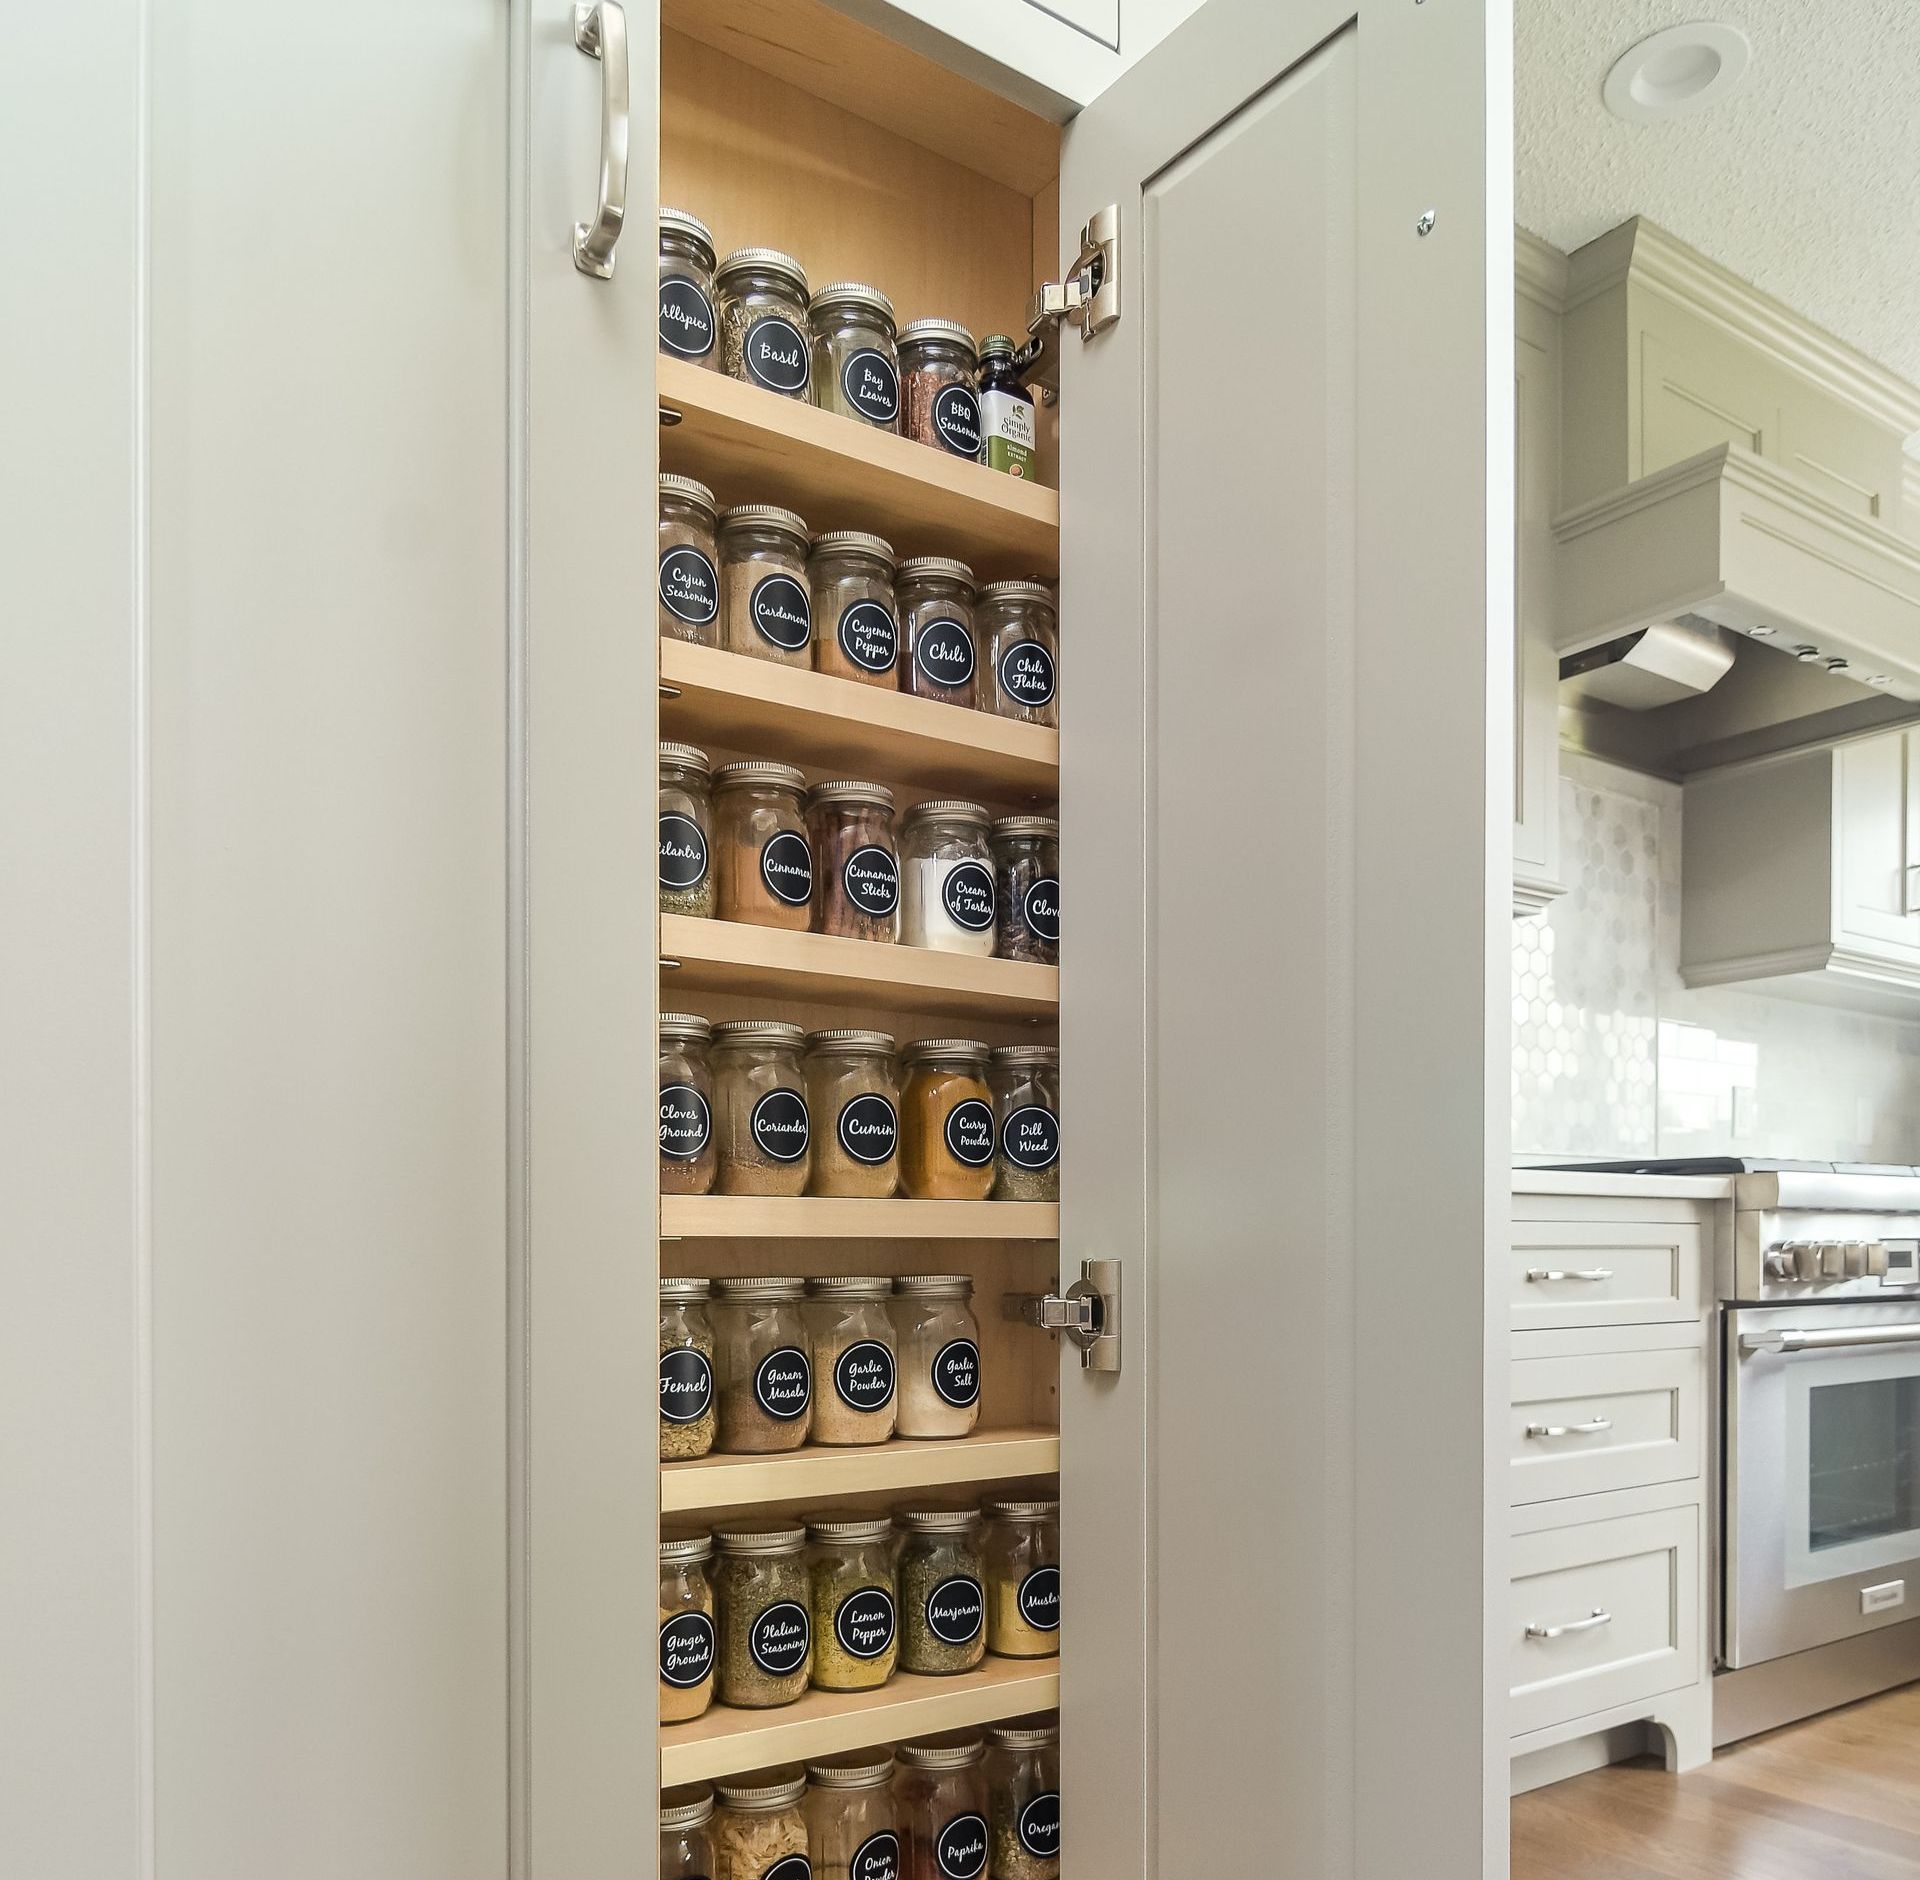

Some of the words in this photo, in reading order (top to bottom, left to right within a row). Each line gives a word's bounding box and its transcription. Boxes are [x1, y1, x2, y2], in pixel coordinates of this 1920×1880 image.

[659, 304, 708, 330] Allspice
[760, 342, 799, 368] Basil
[863, 368, 884, 390] Bay
[859, 385, 893, 407] Leaves
[951, 401, 970, 421] BBQ
[1001, 423, 1032, 443] Organic
[1002, 416, 1030, 433] Simply
[672, 567, 707, 588] Cajun
[666, 584, 714, 611] Seasoning
[758, 603, 808, 628] Cardamom
[852, 619, 892, 640] Cayenne
[855, 637, 889, 659] Pepper
[929, 643, 966, 663] Chili
[1017, 658, 1044, 674] Chili
[1012, 674, 1047, 691] Flakes
[659, 840, 701, 860] ilantro
[849, 864, 897, 883] Cinnamon
[861, 882, 891, 898] Sticks
[956, 880, 987, 897] Cream
[951, 895, 961, 911] of
[963, 898, 992, 915] Tartar
[660, 1104, 698, 1119] Cloves
[659, 1123, 703, 1140] Ground
[757, 1119, 806, 1134] Coriander
[849, 1118, 894, 1136] Cumin
[959, 1117, 987, 1135] Curry
[1020, 1123, 1043, 1136] Dill
[960, 1134, 990, 1147] Powder
[1019, 1138, 1049, 1152] Weed
[848, 1359, 882, 1378] Garlic
[947, 1357, 974, 1376] Garlic
[659, 1373, 707, 1394] Fennel
[767, 1369, 803, 1384] Garam
[850, 1376, 886, 1392] Powder
[954, 1372, 973, 1387] Salt
[767, 1383, 805, 1400] Masala
[850, 1610, 885, 1624] Lemon
[931, 1605, 980, 1621] Marjoram
[762, 1621, 801, 1639] Italian
[852, 1626, 887, 1645] Pepper
[667, 1634, 706, 1652] Ginger
[760, 1639, 805, 1655] Seasoning
[667, 1646, 709, 1671] Ground
[947, 1838, 983, 1864] Paprika
[865, 1856, 892, 1870] Onion
